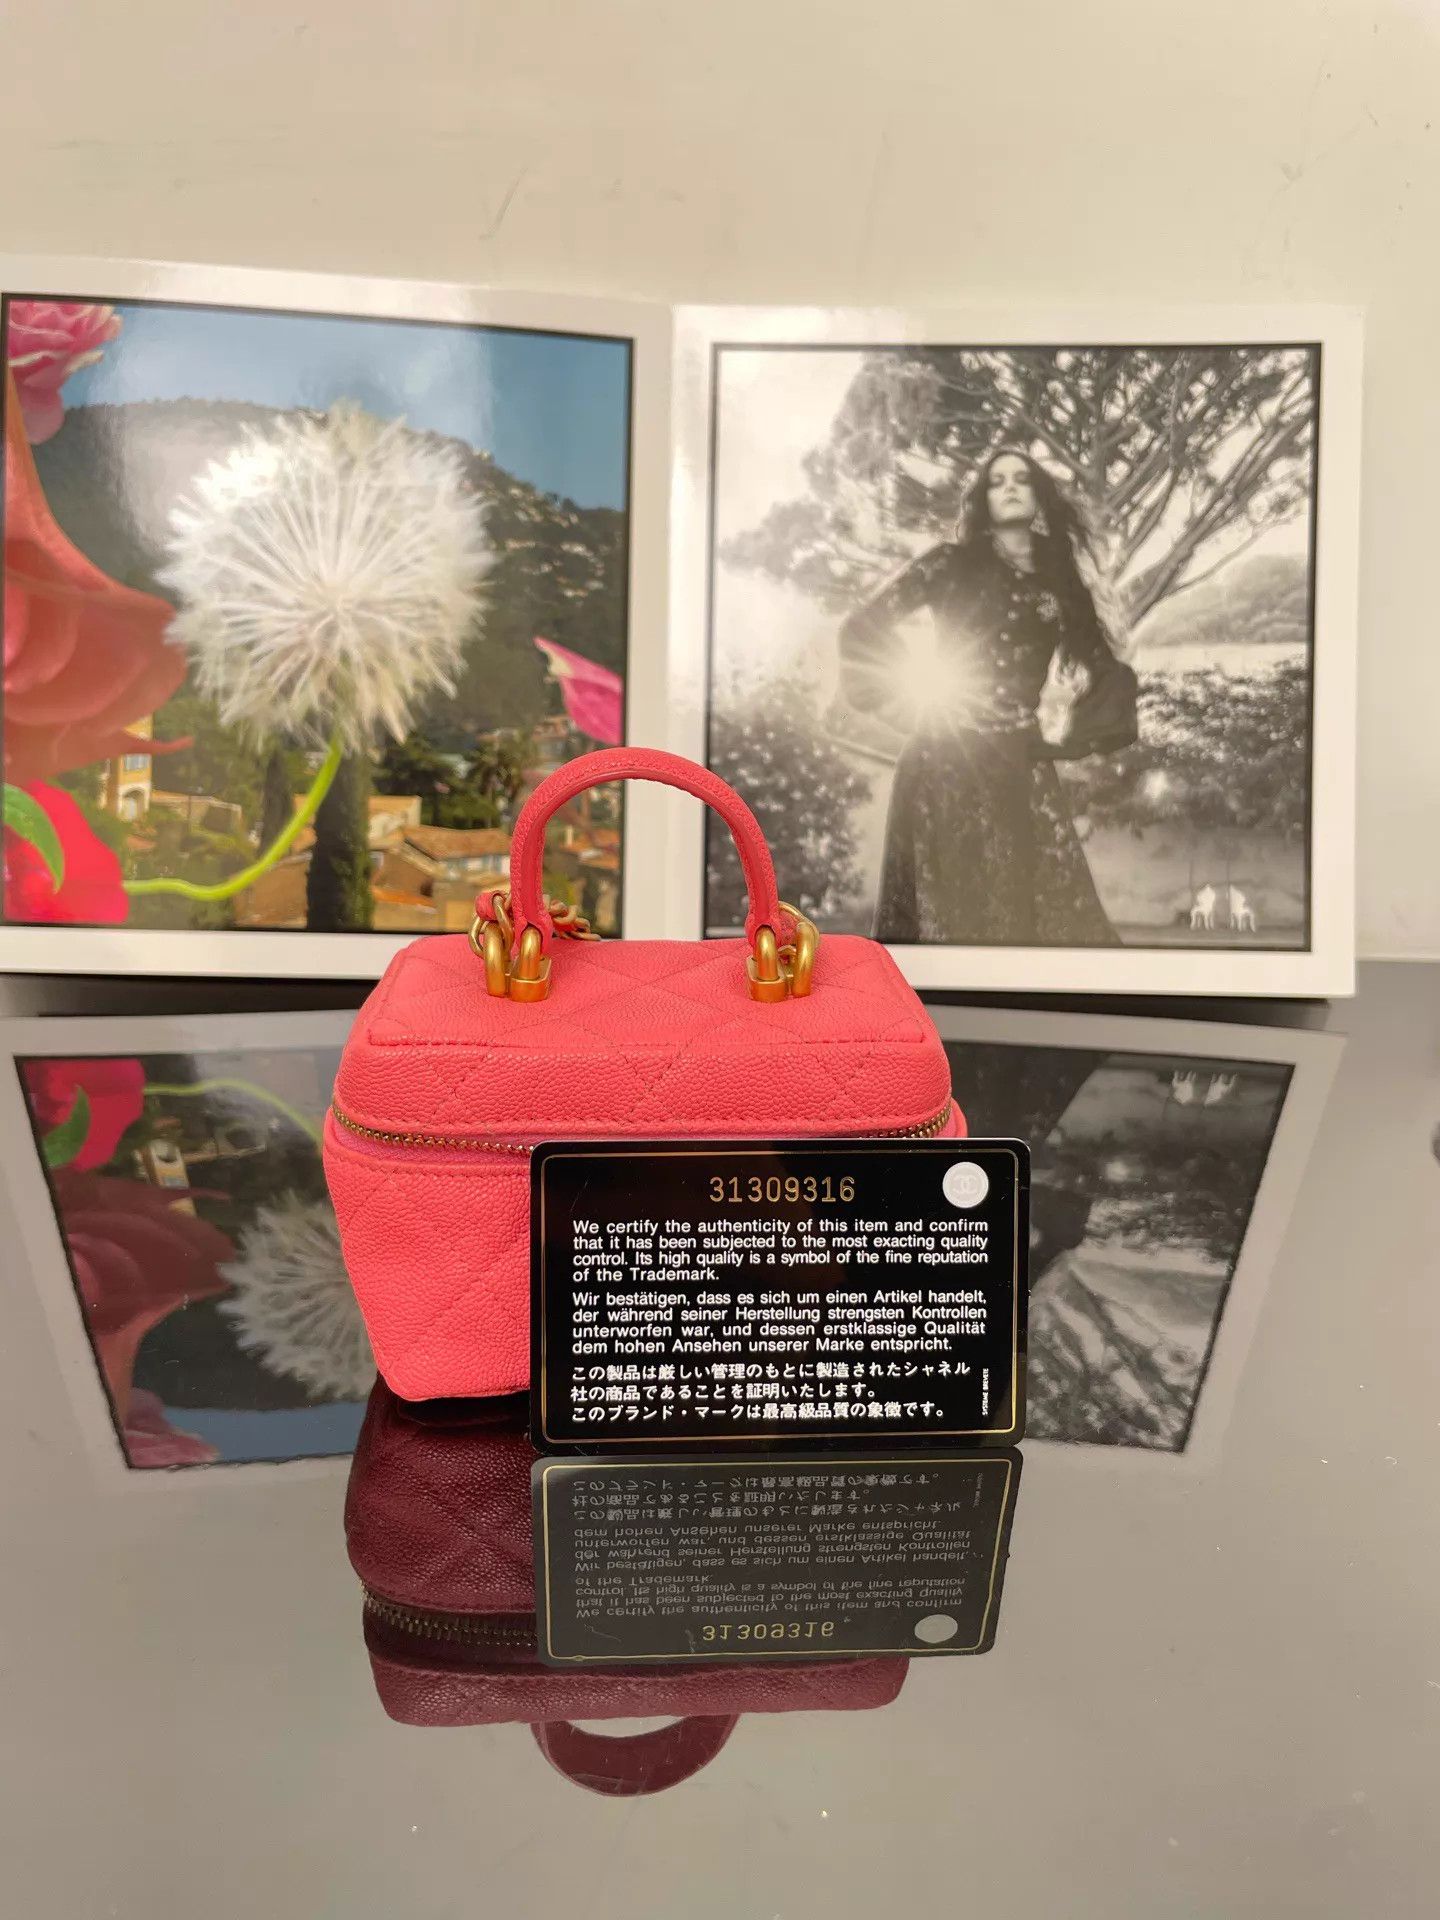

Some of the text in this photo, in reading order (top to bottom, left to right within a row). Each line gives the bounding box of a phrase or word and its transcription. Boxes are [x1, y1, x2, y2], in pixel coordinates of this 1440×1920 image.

[710, 1177, 854, 1202] 31309316
[573, 1219, 988, 1235] We certify the authenticity of this item and confirm
[573, 1234, 988, 1251] that it has been subjected to the most exacting quality
[573, 1251, 988, 1267] control. Its high quality is a symbol of the fine reputation
[573, 1267, 719, 1282] of the Trademark.
[573, 1290, 986, 1307] Wir bestätigen, dass es sich um einen Artikel handelt,
[573, 1306, 986, 1322] der während seiner Herstellung strengsten Kontrollen
[573, 1321, 985, 1338] unterworfen war, und dessen erstklassige Qualität
[573, 1336, 952, 1354] dem hohen Ansehen unserer Marke entspricht.
[573, 1361, 970, 1381] この製品は厳しい管理のもとに製造されたシャネル
[571, 1383, 877, 1402] 社の商品であることを証明いたします。
[573, 1401, 943, 1421] このブランド・マークは最高級品質の象徴です。
